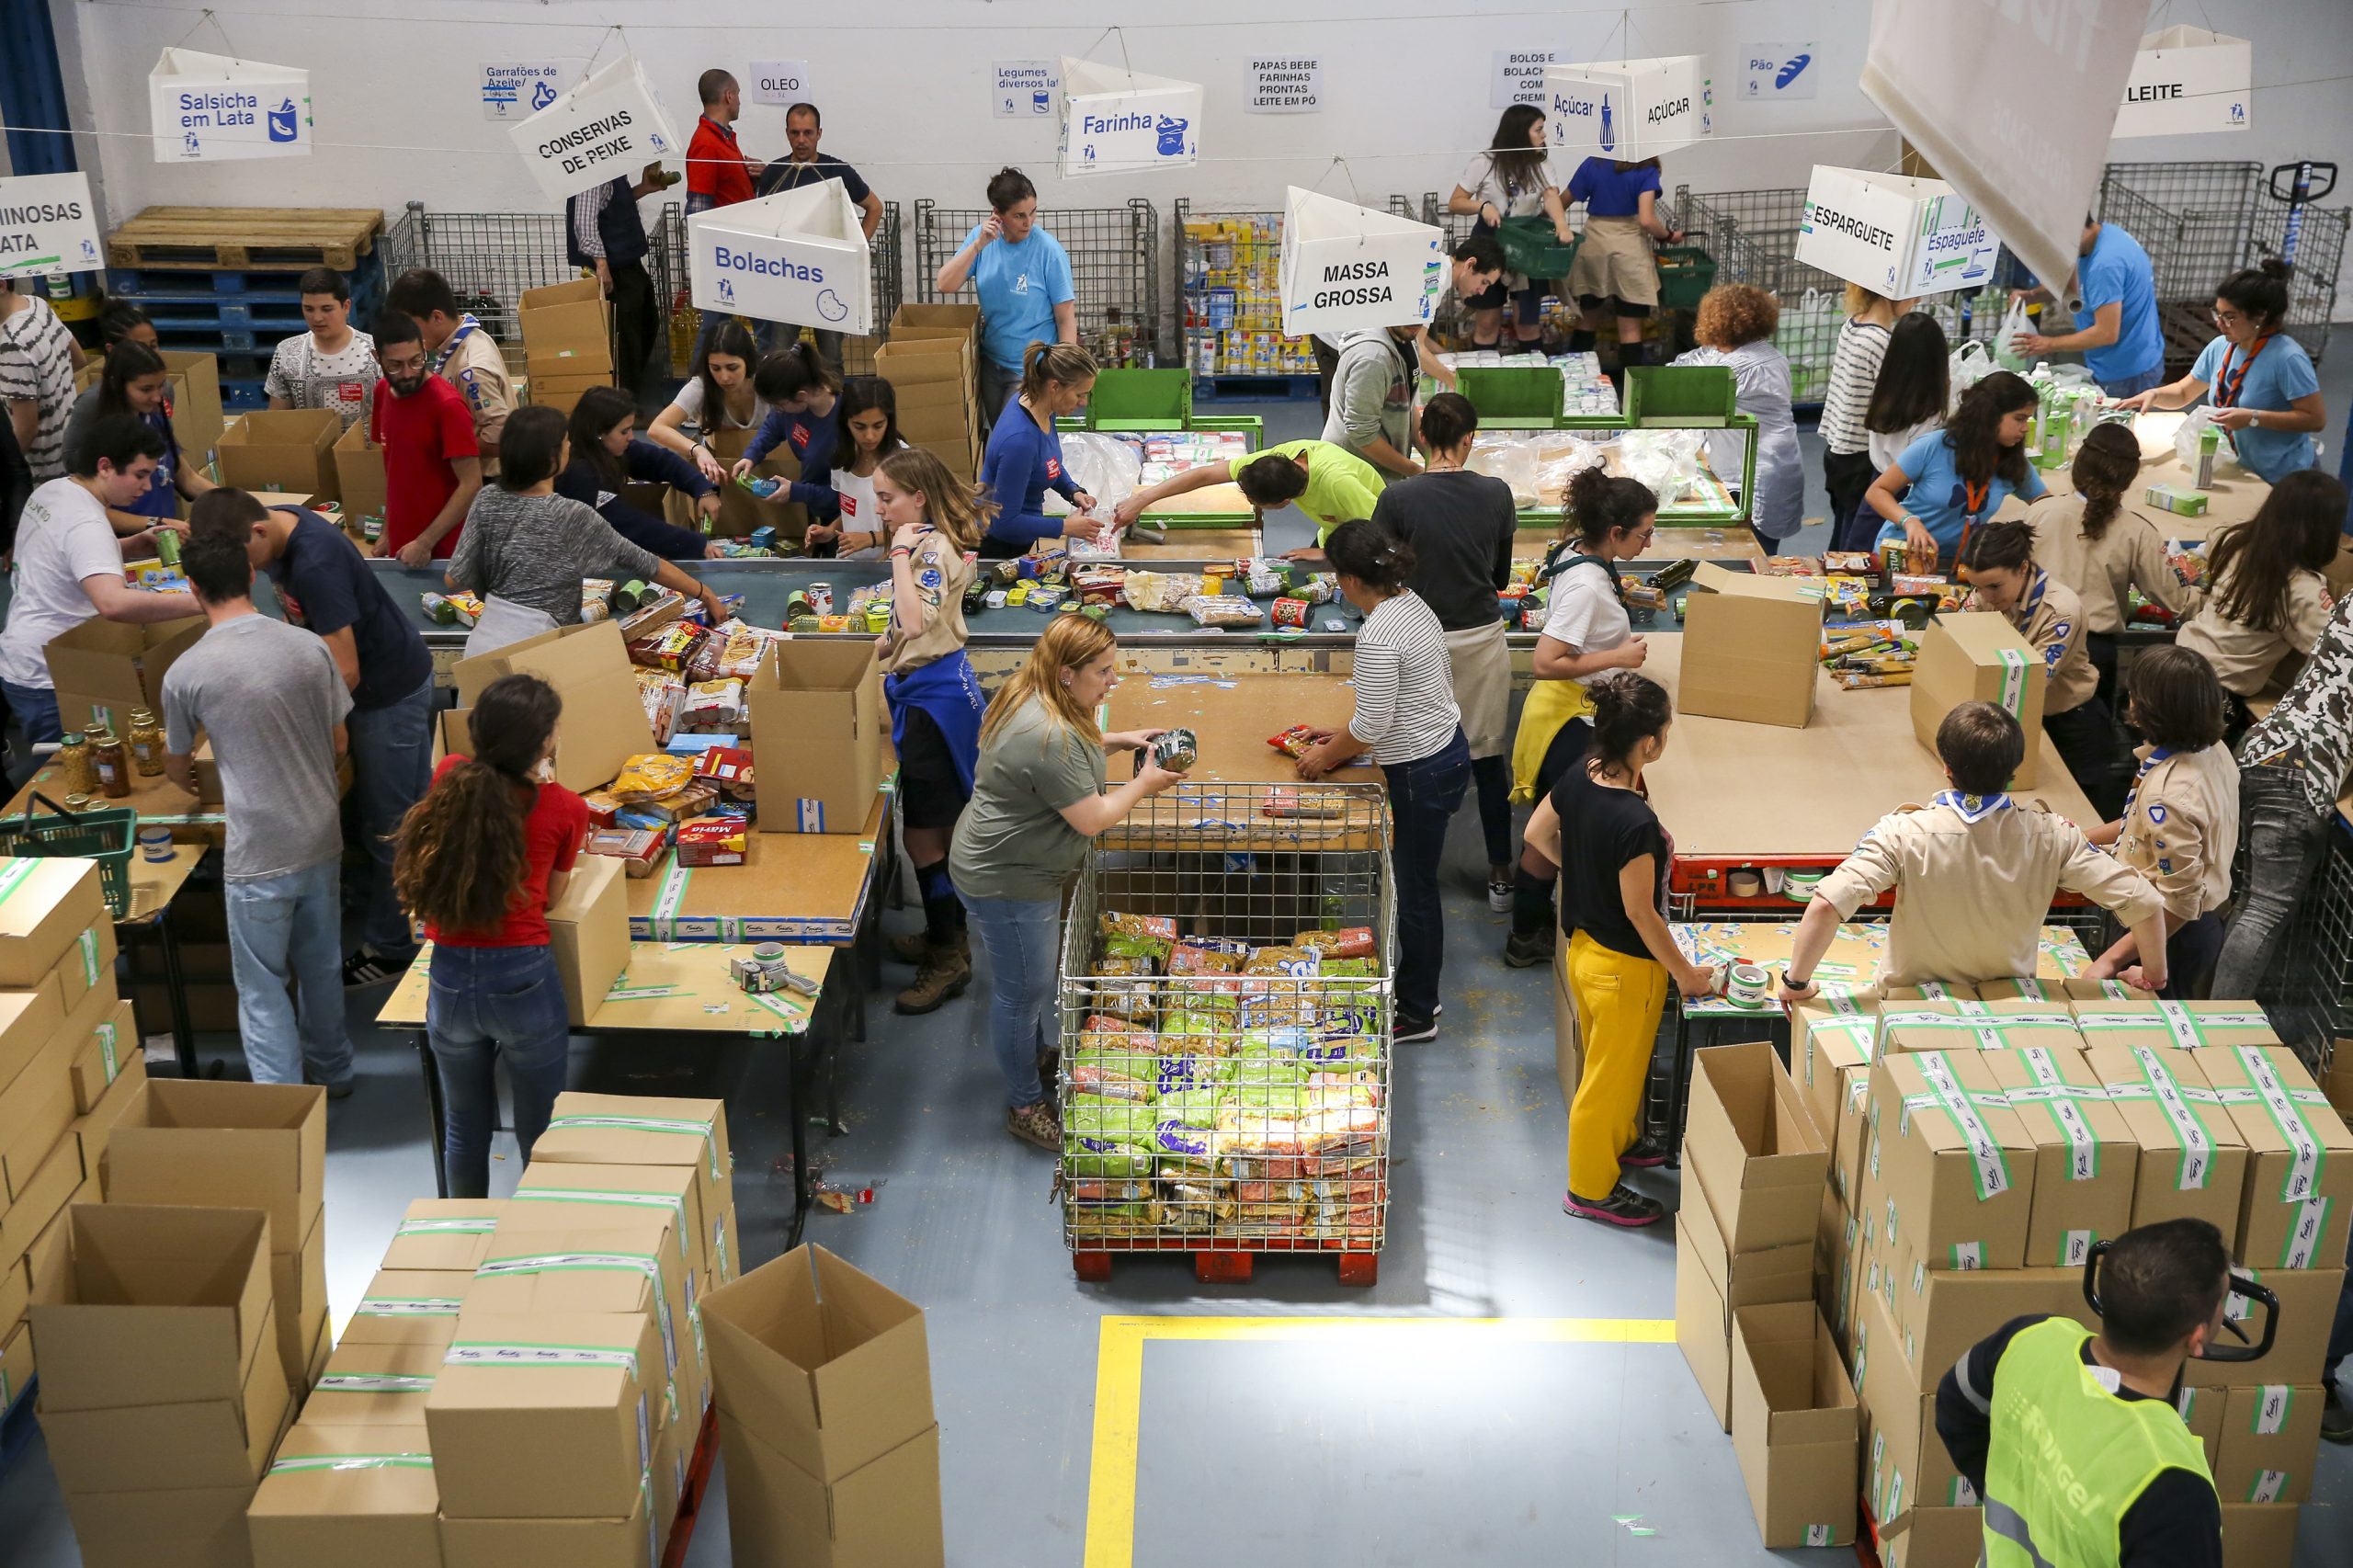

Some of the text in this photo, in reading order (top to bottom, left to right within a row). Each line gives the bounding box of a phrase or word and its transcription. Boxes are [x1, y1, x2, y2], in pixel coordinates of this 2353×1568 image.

[1253, 61, 1317, 70] PAPAS BEBE
[1510, 53, 1554, 63] BOLOS E
[1750, 59, 1773, 70] Pão
[486, 66, 557, 77] Garrafões de
[998, 68, 1047, 79] Legumes
[1259, 73, 1311, 82] FARINHAS
[761, 78, 799, 90] OLEO
[998, 79, 1058, 88] diversos lat
[1259, 85, 1308, 94] PRONTAS
[1520, 80, 1543, 89] COM
[180, 93, 257, 110] Salsicha
[1254, 94, 1316, 106] LEITE EM PÓ
[2128, 84, 2183, 102] LEITE
[1553, 94, 1594, 118] Açúcar
[1648, 97, 1689, 125] AÇÚCAR
[181, 110, 254, 127] em Lata
[1083, 112, 1152, 134] Farinha
[539, 110, 632, 159] CONSERVAS
[562, 135, 632, 175] DE PEIXE
[0, 202, 82, 225] INOSAS
[1814, 206, 1893, 251] ESPARGUETE
[0, 233, 39, 253] ATA
[1927, 228, 1985, 253] Espaguete
[715, 246, 824, 283] Bolachas
[1324, 261, 1389, 282] MASSA
[1314, 287, 1392, 309] GROSSA
[1891, 550, 1900, 572] STUM
